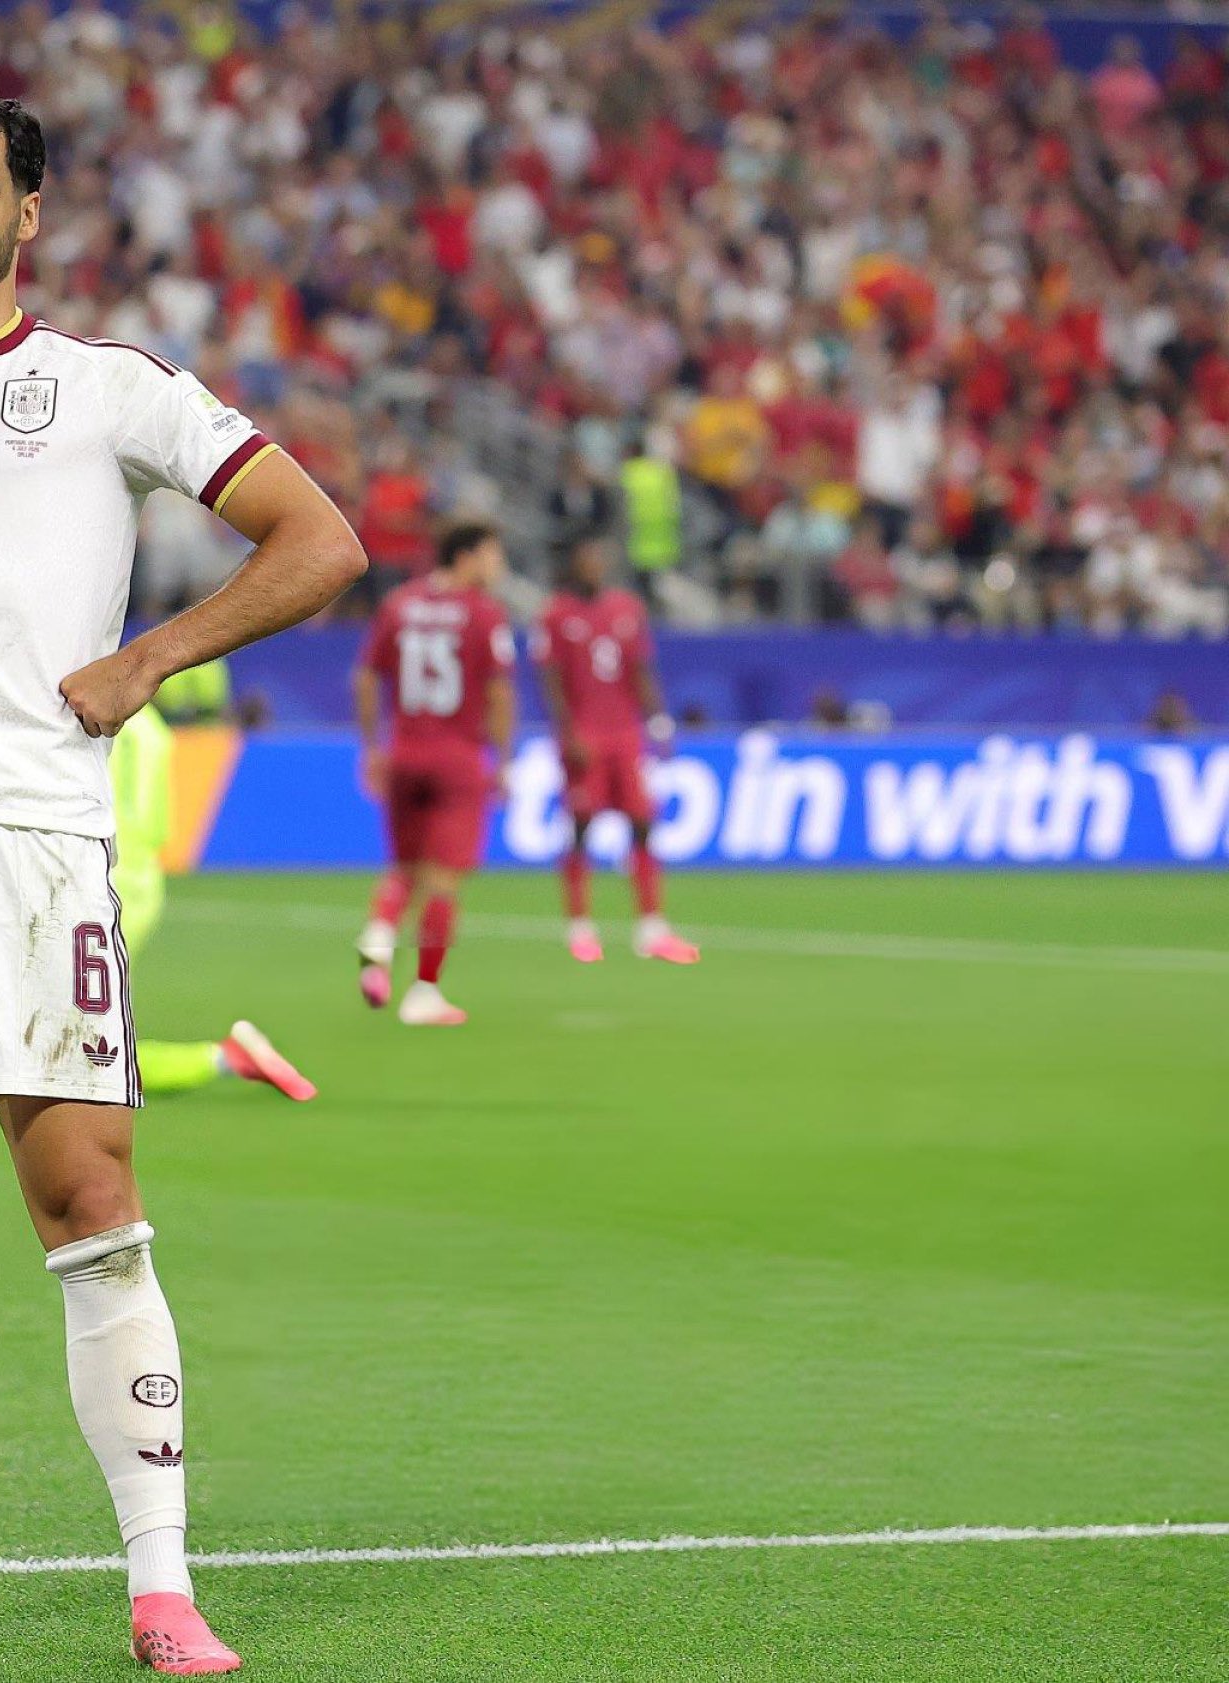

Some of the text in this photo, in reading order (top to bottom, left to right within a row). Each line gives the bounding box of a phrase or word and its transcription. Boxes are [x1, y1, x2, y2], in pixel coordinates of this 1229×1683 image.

[397, 627, 464, 718] 15
[720, 729, 848, 862] in
[864, 734, 1135, 861] with
[73, 921, 112, 1015] 6
